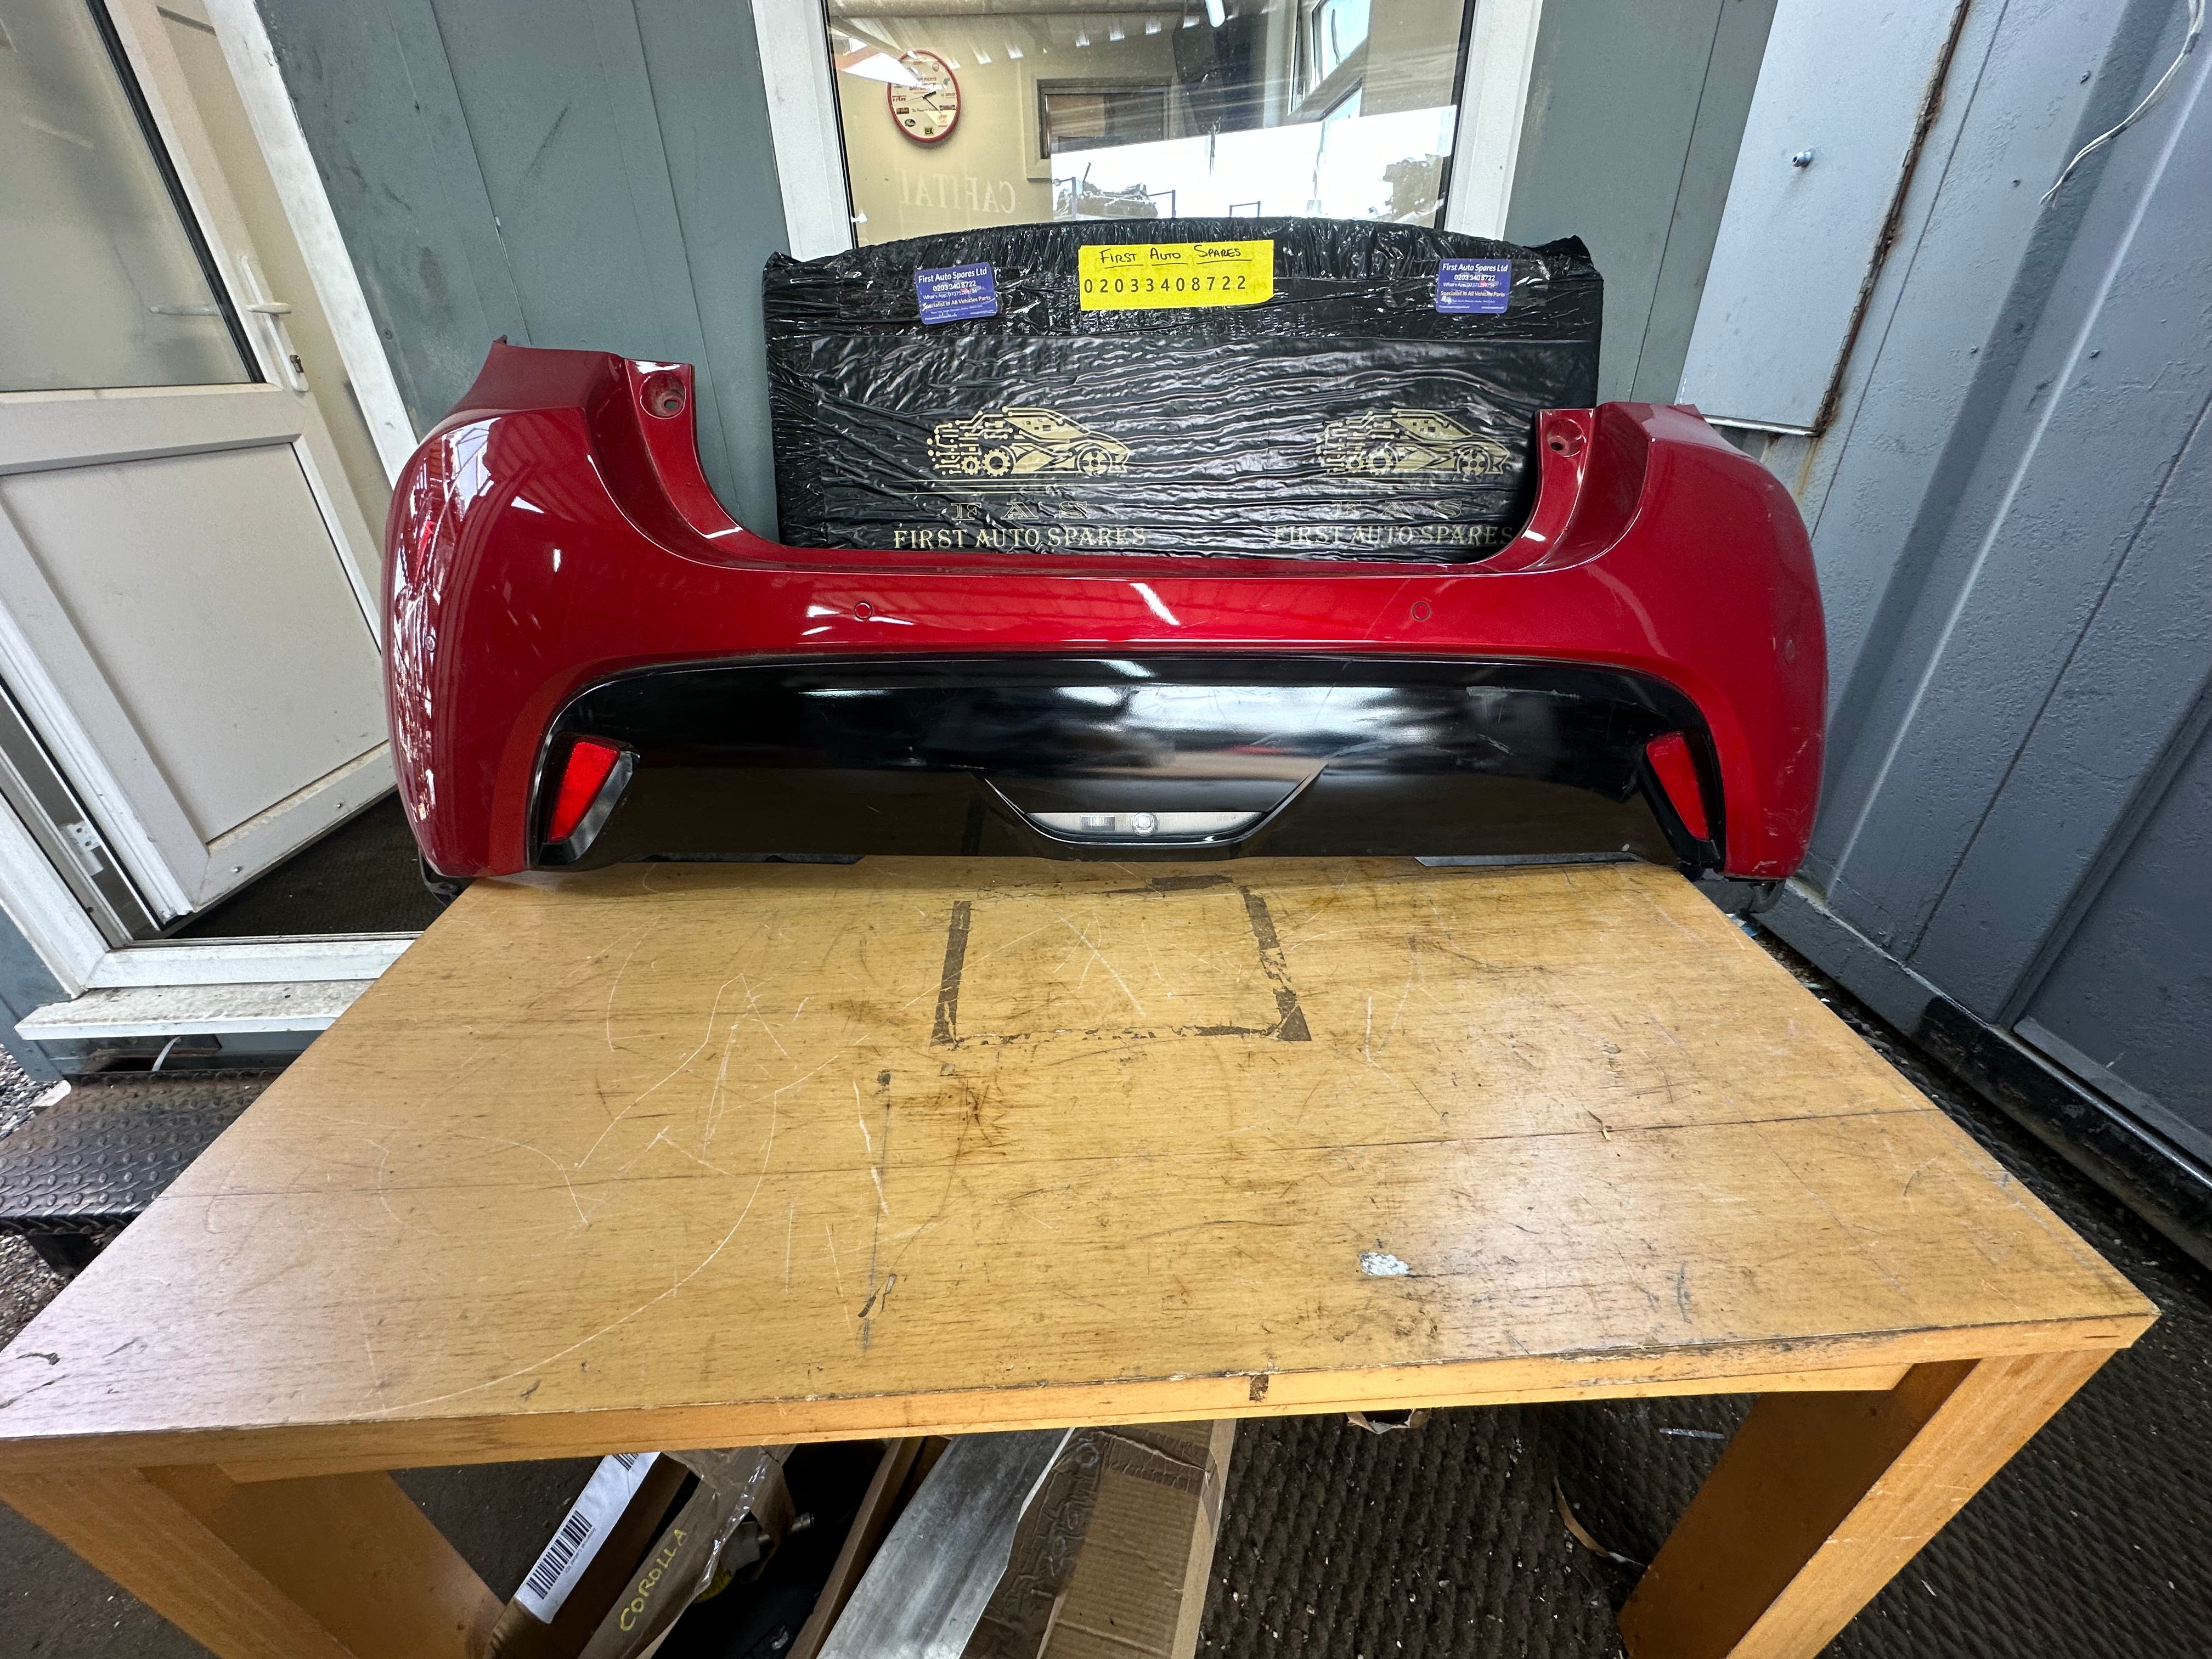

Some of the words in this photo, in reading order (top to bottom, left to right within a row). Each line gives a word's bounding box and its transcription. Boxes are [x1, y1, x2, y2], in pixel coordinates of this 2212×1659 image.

[1099, 248, 1137, 264] FIRST
[1150, 247, 1181, 260] AUTO
[1193, 245, 1242, 258] SPARES
[918, 275, 934, 283] First
[935, 273, 952, 282] Auto
[952, 270, 975, 280] Spares
[975, 267, 988, 276] Ltd
[1475, 264, 1496, 273] Spares
[933, 283, 949, 292] 0203
[961, 280, 977, 288] 8722
[893, 529, 967, 549] FIRST
[976, 528, 1040, 548] AUTO
[1048, 527, 1146, 548] SPARES
[1272, 526, 1345, 545] FIRST
[1350, 525, 1414, 545] AUTO
[1420, 526, 1513, 545] SPARES
[620, 1529, 686, 1631] COROLLA
